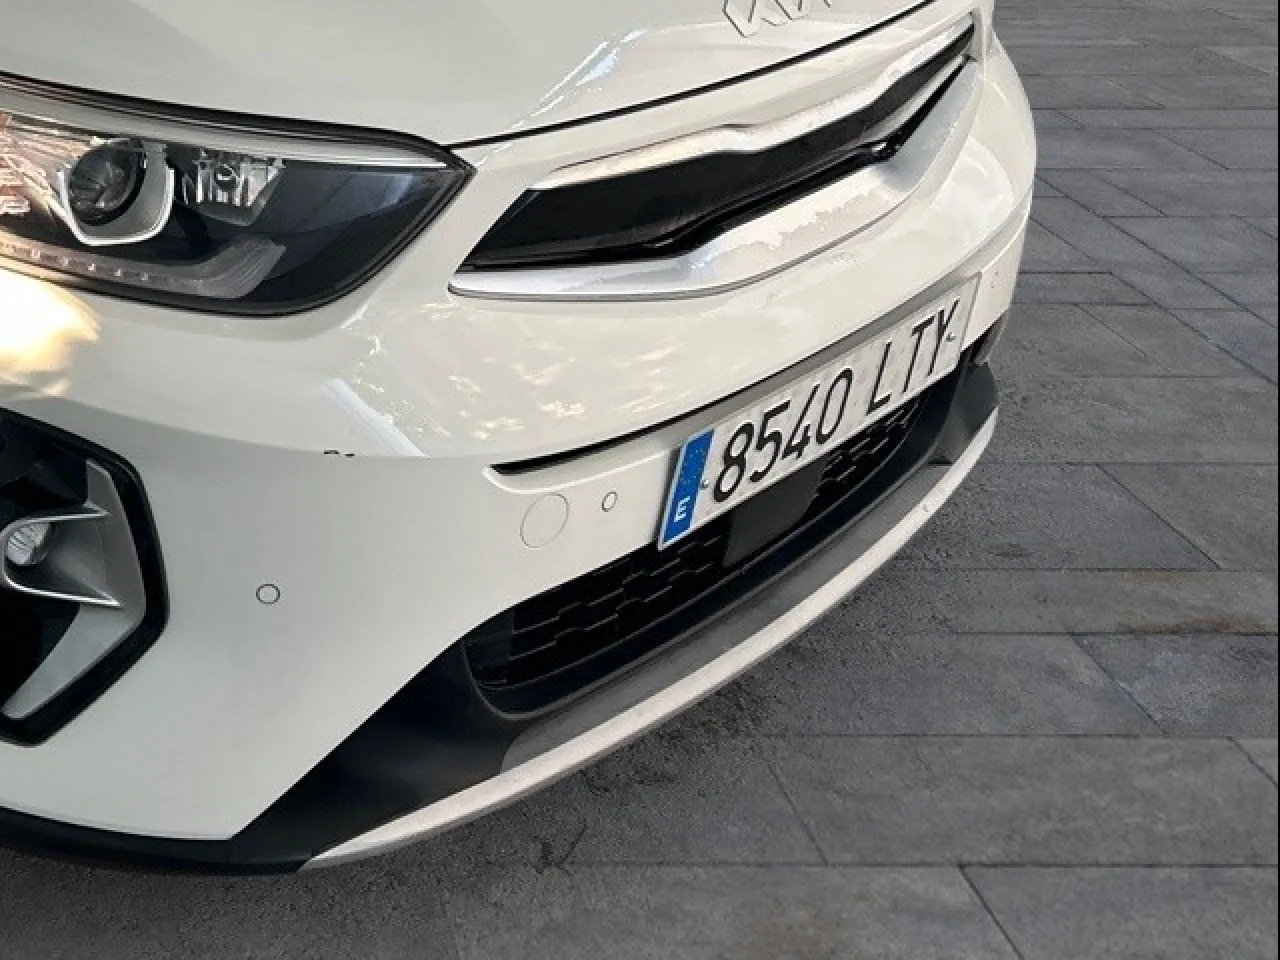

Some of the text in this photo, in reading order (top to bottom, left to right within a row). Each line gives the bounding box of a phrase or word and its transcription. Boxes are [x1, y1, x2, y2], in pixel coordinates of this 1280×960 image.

[713, 296, 960, 503] 8540 LTY
[673, 495, 691, 523] E
